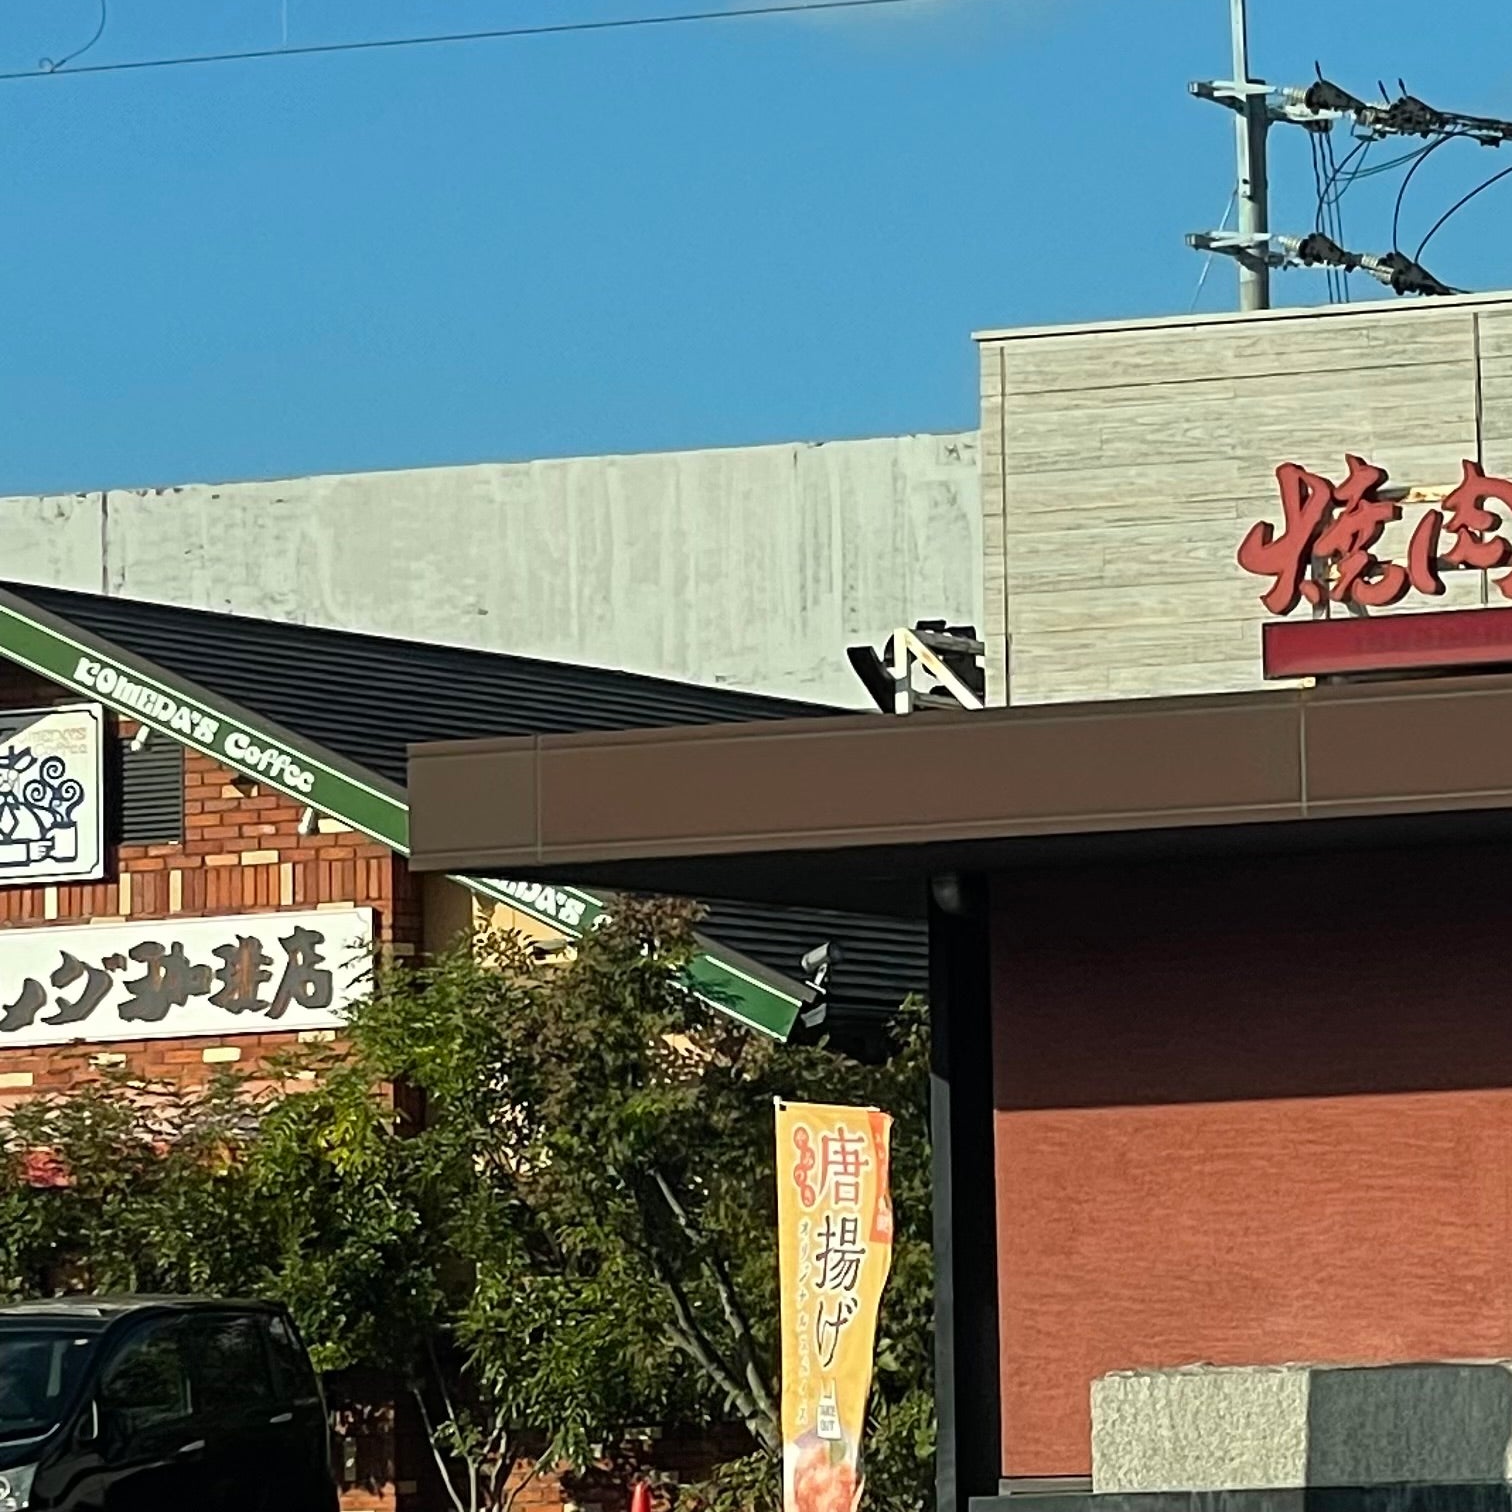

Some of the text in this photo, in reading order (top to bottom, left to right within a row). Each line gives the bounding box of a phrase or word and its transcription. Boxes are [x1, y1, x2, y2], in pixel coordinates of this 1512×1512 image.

[73, 656, 315, 794] KOMEDA'S Coffee
[815, 1126, 870, 1368] 唐揚げ
